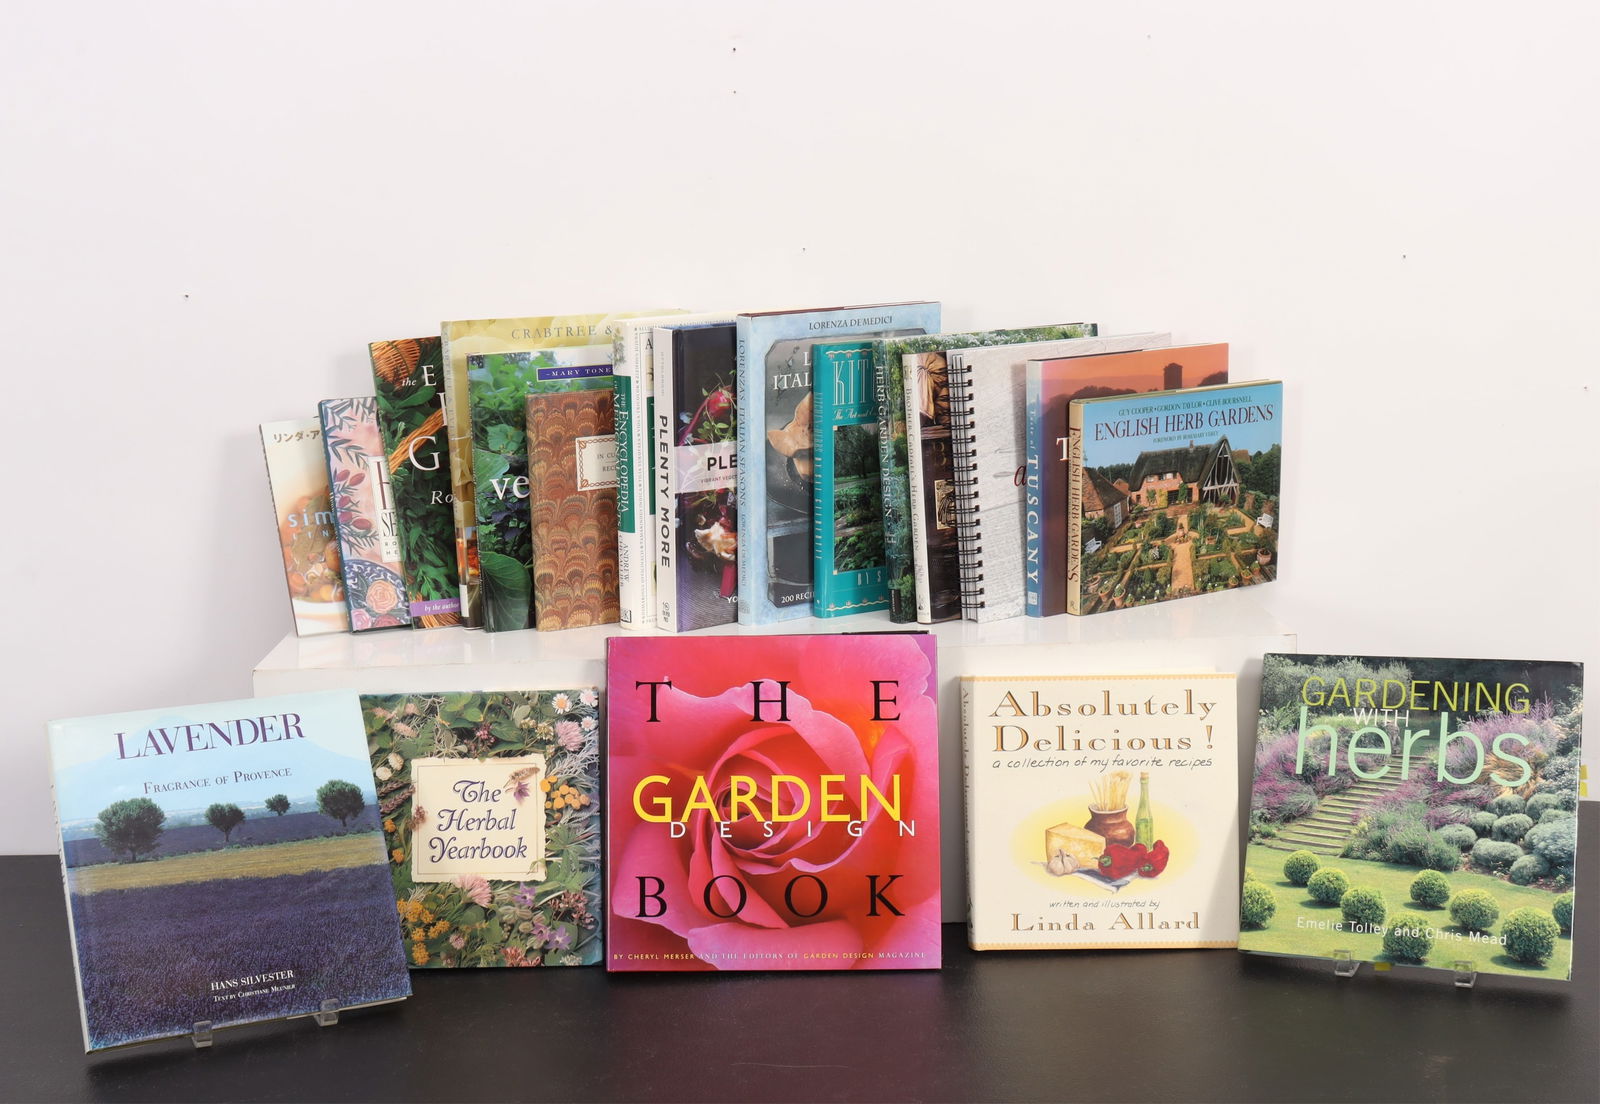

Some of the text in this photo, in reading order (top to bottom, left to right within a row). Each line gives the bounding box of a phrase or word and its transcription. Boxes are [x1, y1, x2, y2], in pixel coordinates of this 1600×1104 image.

[511, 325, 613, 340] CRABTREE &
[808, 319, 848, 331] LORENZA
[401, 377, 417, 387] the
[551, 369, 580, 378] MARY
[832, 358, 874, 406] KIT
[905, 388, 914, 431] BROTHER
[1118, 407, 1130, 417] GUY
[1131, 405, 1154, 415] COOPER
[1156, 402, 1181, 412] GORDON
[1182, 400, 1202, 410] TAYLOR
[1206, 398, 1221, 408] CLIVE
[1094, 404, 1274, 441] ENGLISH HERB GARDENS
[875, 366, 892, 518] HERB GARDEN DESIGN
[619, 410, 629, 512] ENCYCLOPEDIA
[659, 415, 670, 568] PLENTY MORE
[1067, 427, 1081, 582] ENGLISH HERB GARDENS
[1026, 454, 1039, 585] TUSCANY
[622, 543, 630, 583] ANDREW
[425, 604, 431, 613] by
[432, 603, 441, 611] the
[781, 591, 815, 604] 200 RECI
[635, 680, 901, 723] THE
[988, 688, 1217, 721] Absolutely
[1301, 676, 1531, 714] GARDENING
[1352, 707, 1409, 727] WITH
[113, 712, 307, 760] LAVENDER
[1295, 705, 1533, 787] herbs
[992, 756, 1213, 773] a collection of my favorite recipes
[452, 780, 502, 803] The
[632, 774, 901, 823] GARDEN
[437, 808, 518, 832] Herbal
[670, 820, 915, 838] DESIGN
[429, 836, 528, 863] Yearbook
[635, 875, 906, 919] BOOK
[1049, 900, 1080, 908] written
[1101, 900, 1146, 908] illustrated
[1149, 900, 1160, 910] by
[1010, 911, 1200, 932] Linda Allard
[1297, 917, 1507, 946] Emelie Tolley and Chris Mead
[210, 969, 295, 991] HANS SILVESTER
